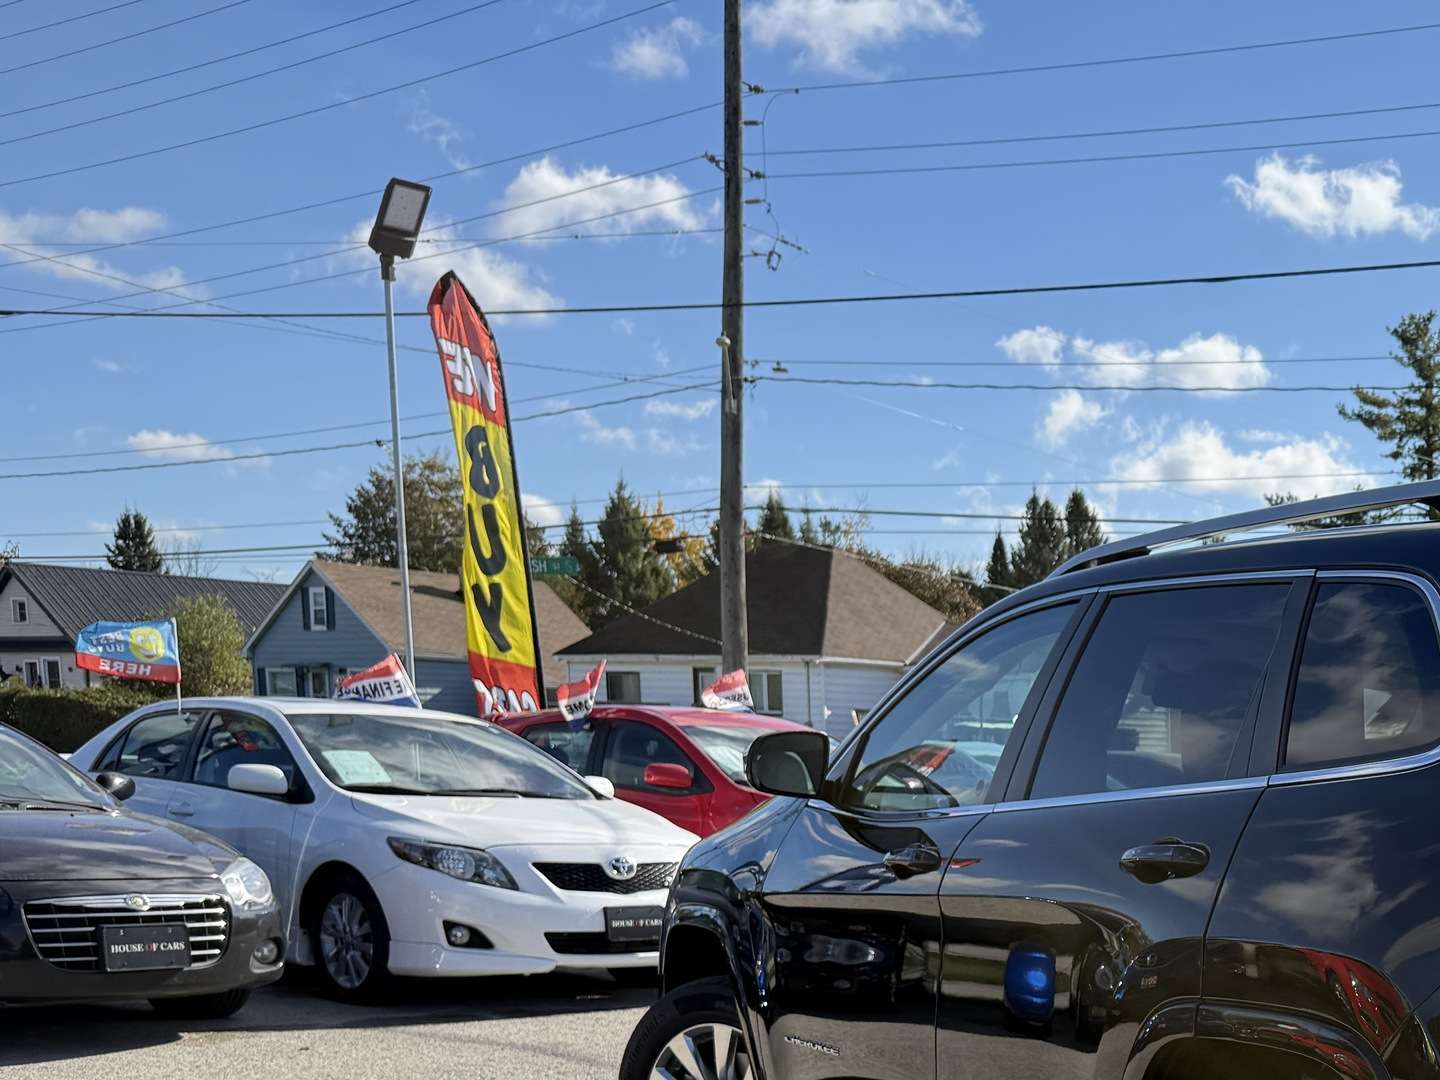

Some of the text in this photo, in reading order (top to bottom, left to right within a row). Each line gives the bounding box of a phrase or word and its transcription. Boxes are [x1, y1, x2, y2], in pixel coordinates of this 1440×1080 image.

[111, 941, 185, 954] HOUSE OF CARS
